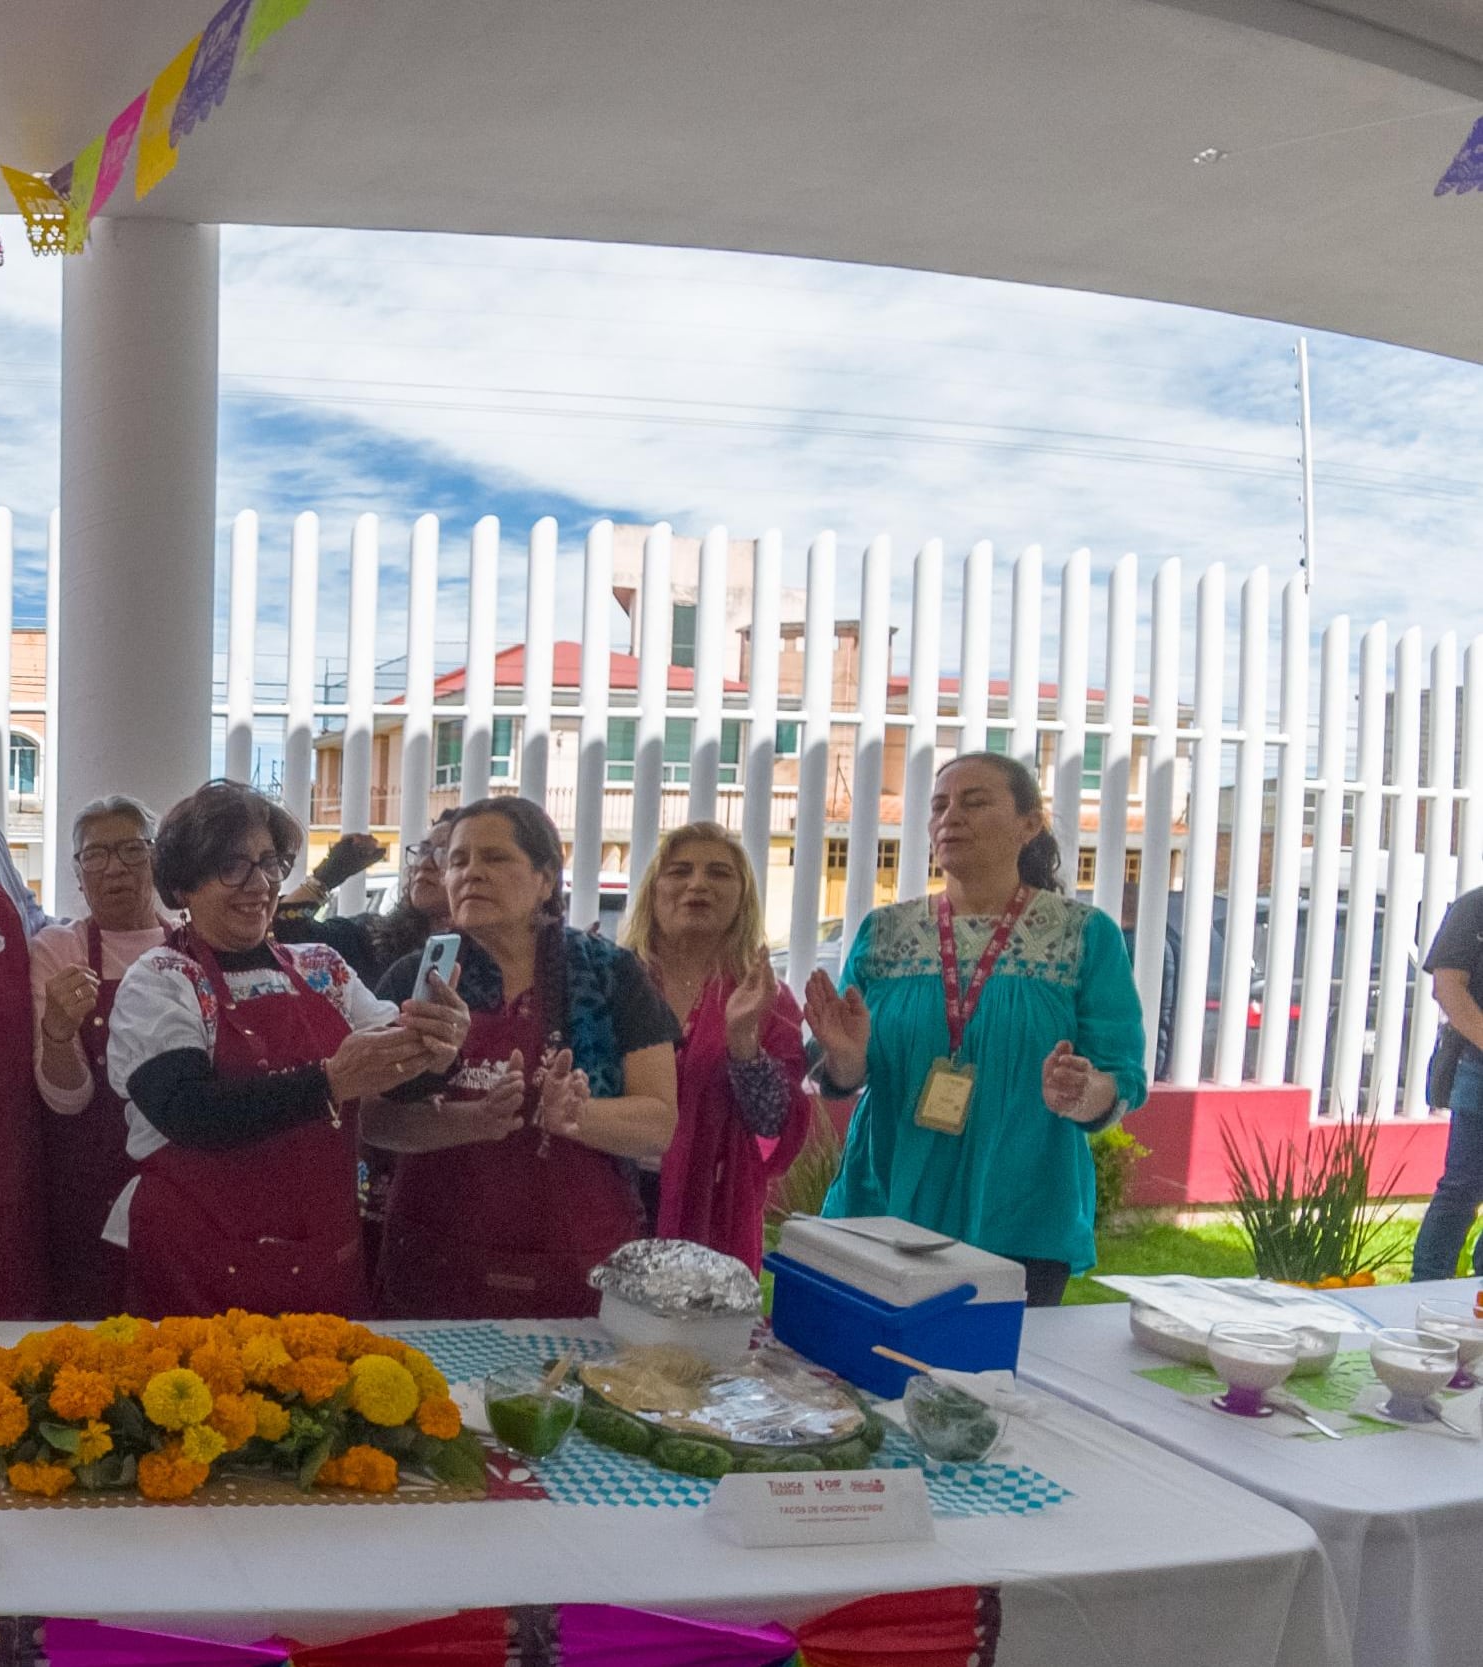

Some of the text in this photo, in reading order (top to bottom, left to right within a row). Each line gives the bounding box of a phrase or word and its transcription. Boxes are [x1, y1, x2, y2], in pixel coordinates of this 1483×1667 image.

[780, 1506, 806, 1514] TACOS
[808, 1505, 818, 1513] DE
[858, 1504, 883, 1512] VERDE
